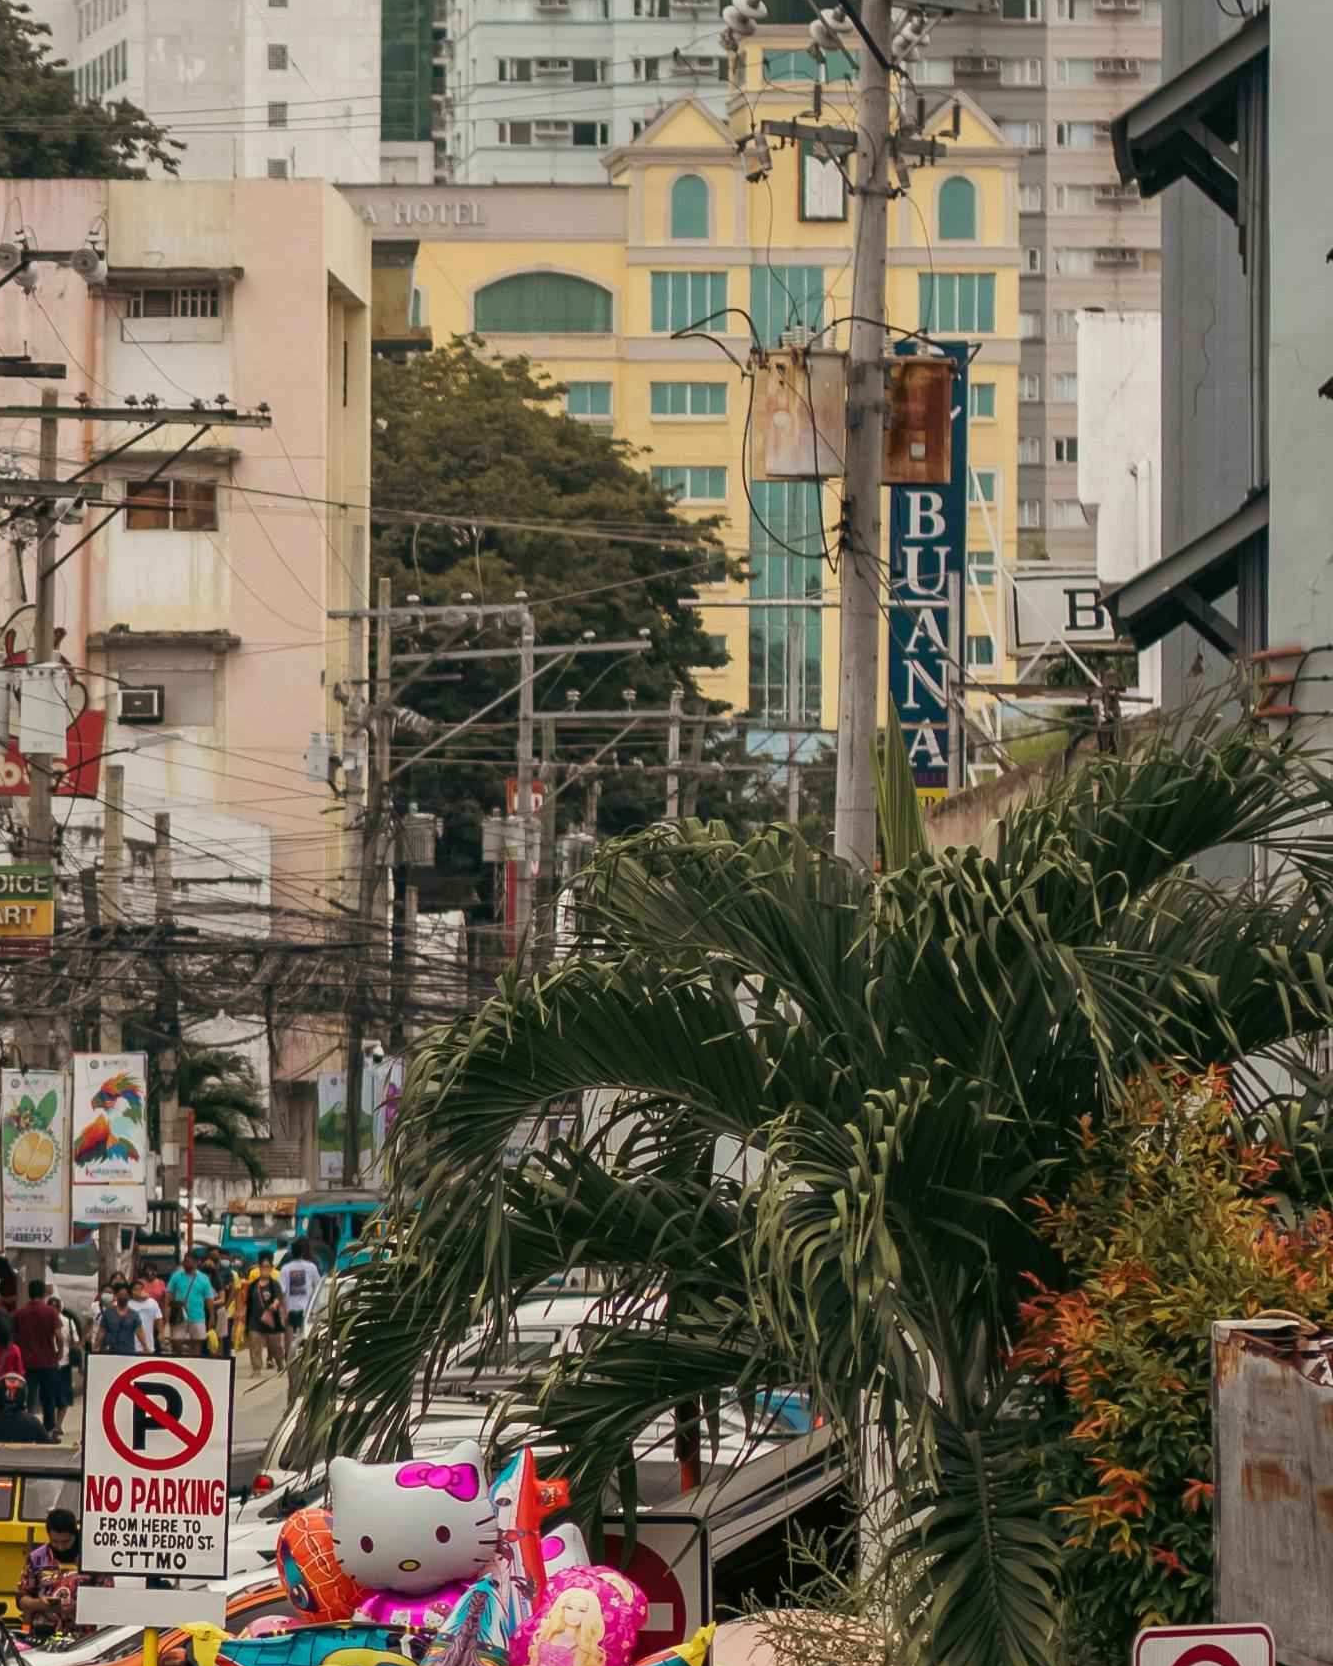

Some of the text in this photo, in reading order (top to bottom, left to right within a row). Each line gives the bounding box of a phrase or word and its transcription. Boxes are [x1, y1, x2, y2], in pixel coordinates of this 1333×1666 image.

[394, 202, 485, 225] HOTEL
[86, 1475, 225, 1516] NO PARKING
[100, 1517, 201, 1533] FROM HERE TO
[123, 1534, 148, 1548] SAN
[152, 1535, 194, 1550] PEDRO
[198, 1536, 215, 1550] ST.
[111, 1551, 187, 1569] CTTMO
